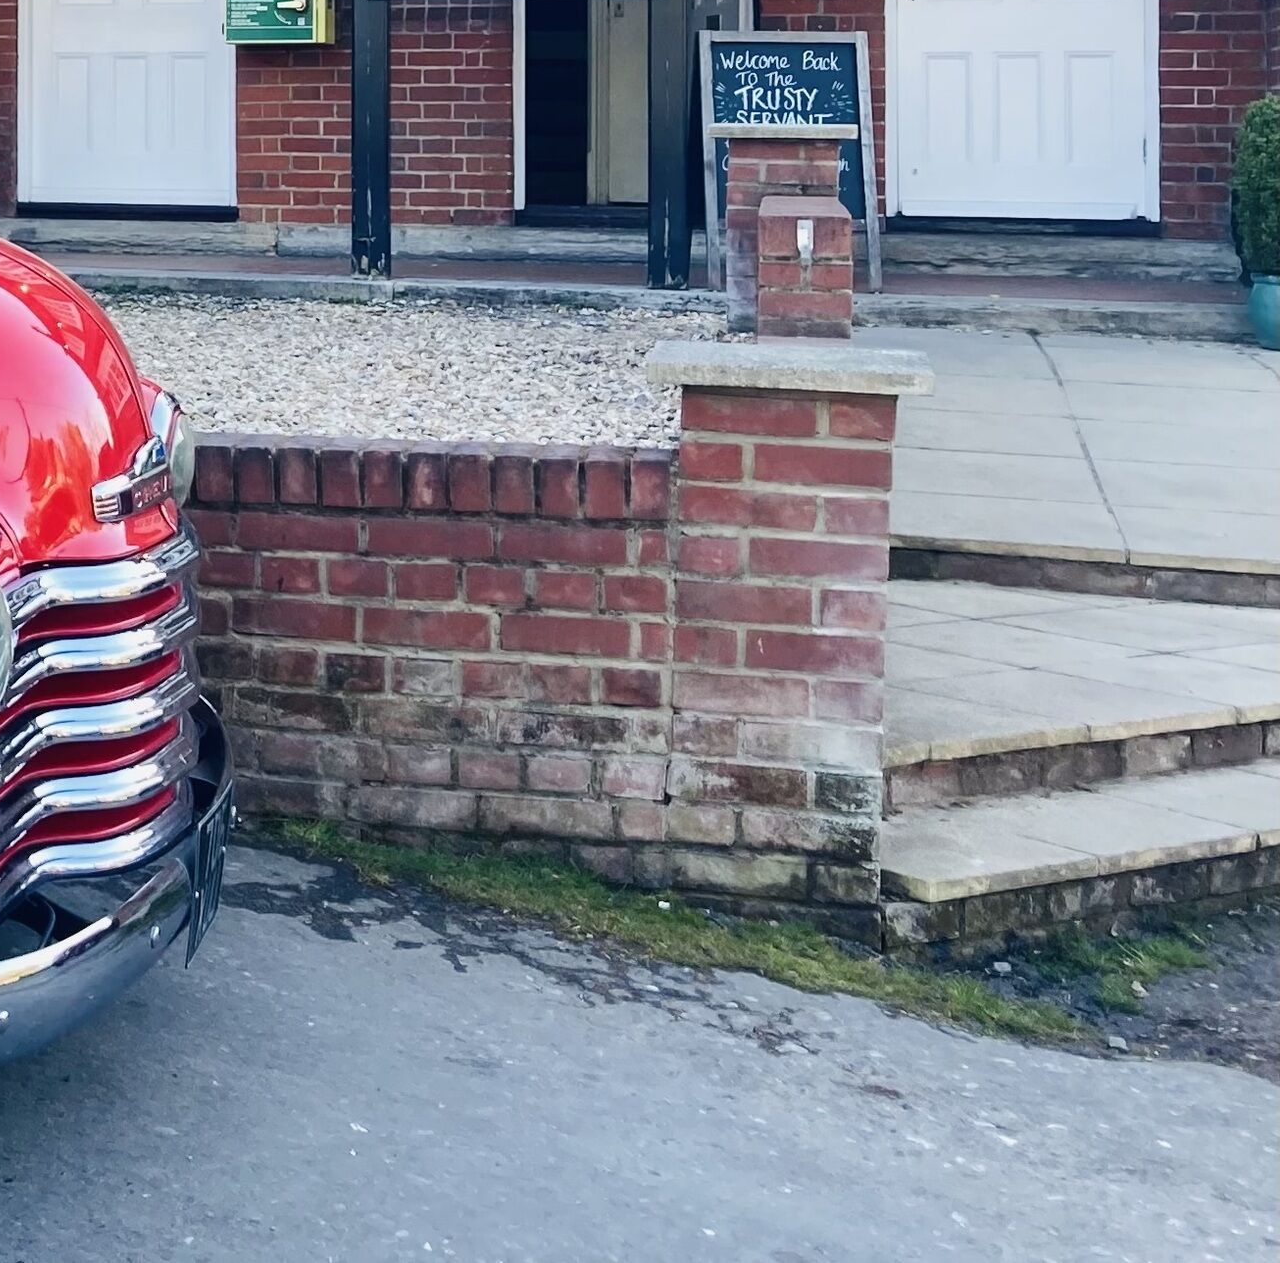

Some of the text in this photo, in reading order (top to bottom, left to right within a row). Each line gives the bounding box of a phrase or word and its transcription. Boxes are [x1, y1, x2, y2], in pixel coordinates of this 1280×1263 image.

[720, 50, 841, 71] Welcome Back
[764, 71, 798, 87] The
[734, 86, 819, 111] TRUSTY
